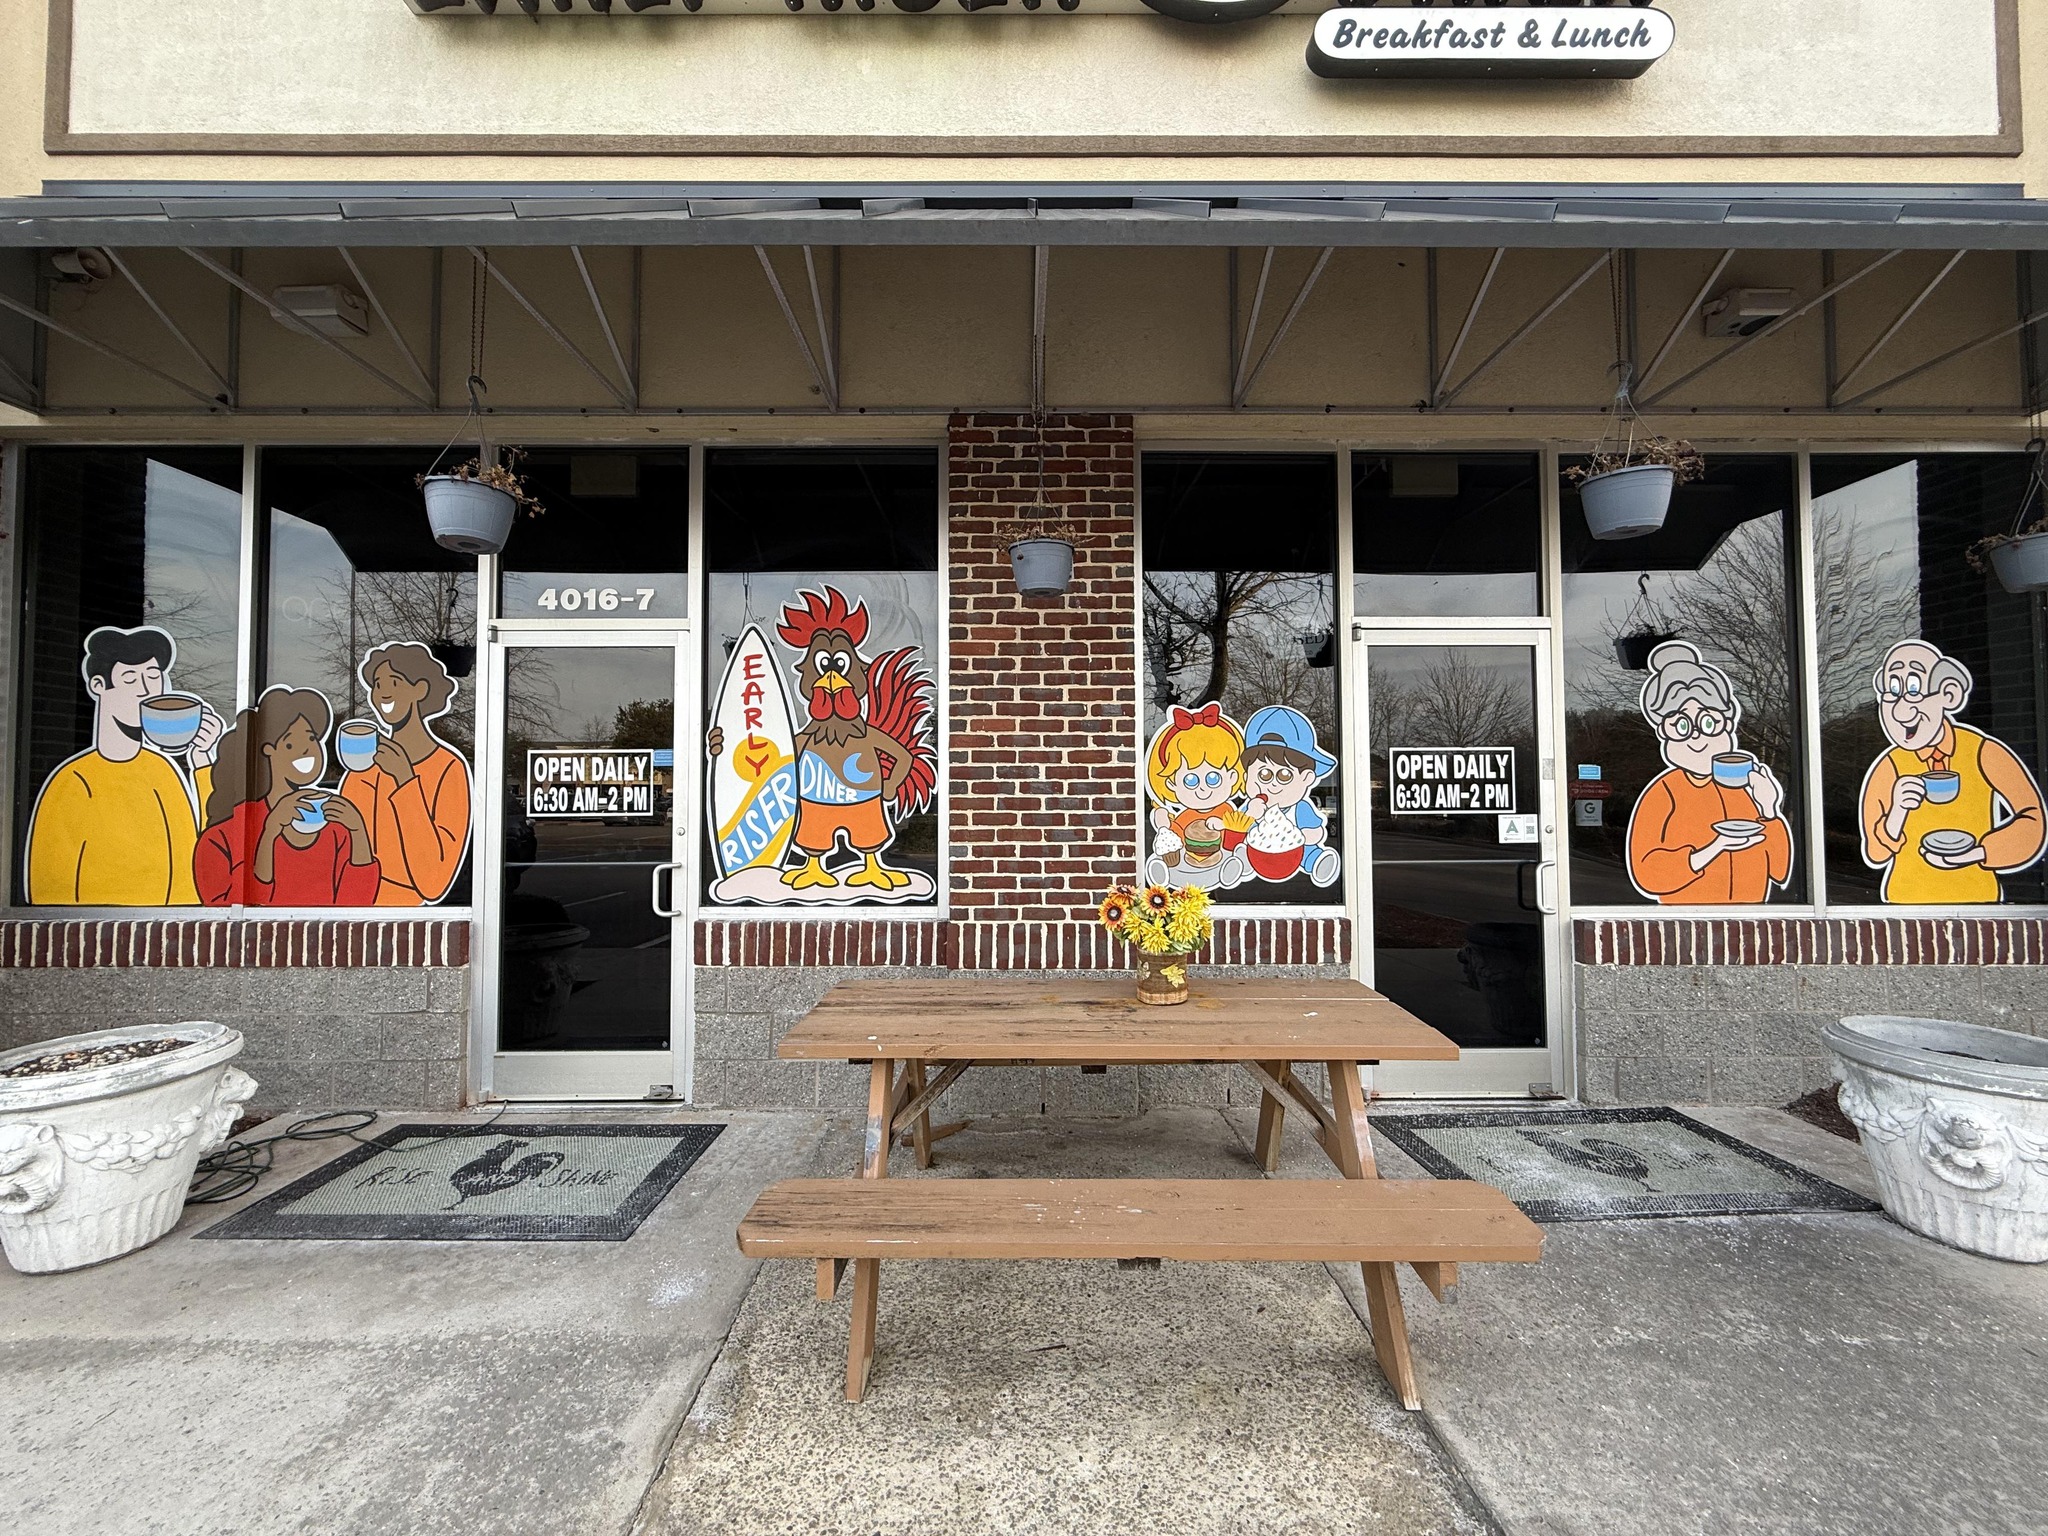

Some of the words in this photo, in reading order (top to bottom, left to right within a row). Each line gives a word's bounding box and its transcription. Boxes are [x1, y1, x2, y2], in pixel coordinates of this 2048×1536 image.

[1332, 18, 1506, 49] Breakfast
[1517, 18, 1541, 48] &
[1551, 18, 1651, 48] Lunch
[537, 588, 655, 611] 4016-7
[741, 654, 769, 777] EARLY
[534, 757, 585, 782] OPEN
[592, 756, 648, 782] DAILY
[800, 753, 858, 802] DINER
[1396, 754, 1447, 779] OPEN
[1453, 754, 1509, 779] DAILY
[533, 787, 568, 812] 6:30
[623, 786, 647, 811] PM
[1396, 784, 1431, 808] 6:30
[1485, 784, 1509, 808] PM
[722, 772, 796, 868] RISER
[1506, 820, 1519, 833] A
